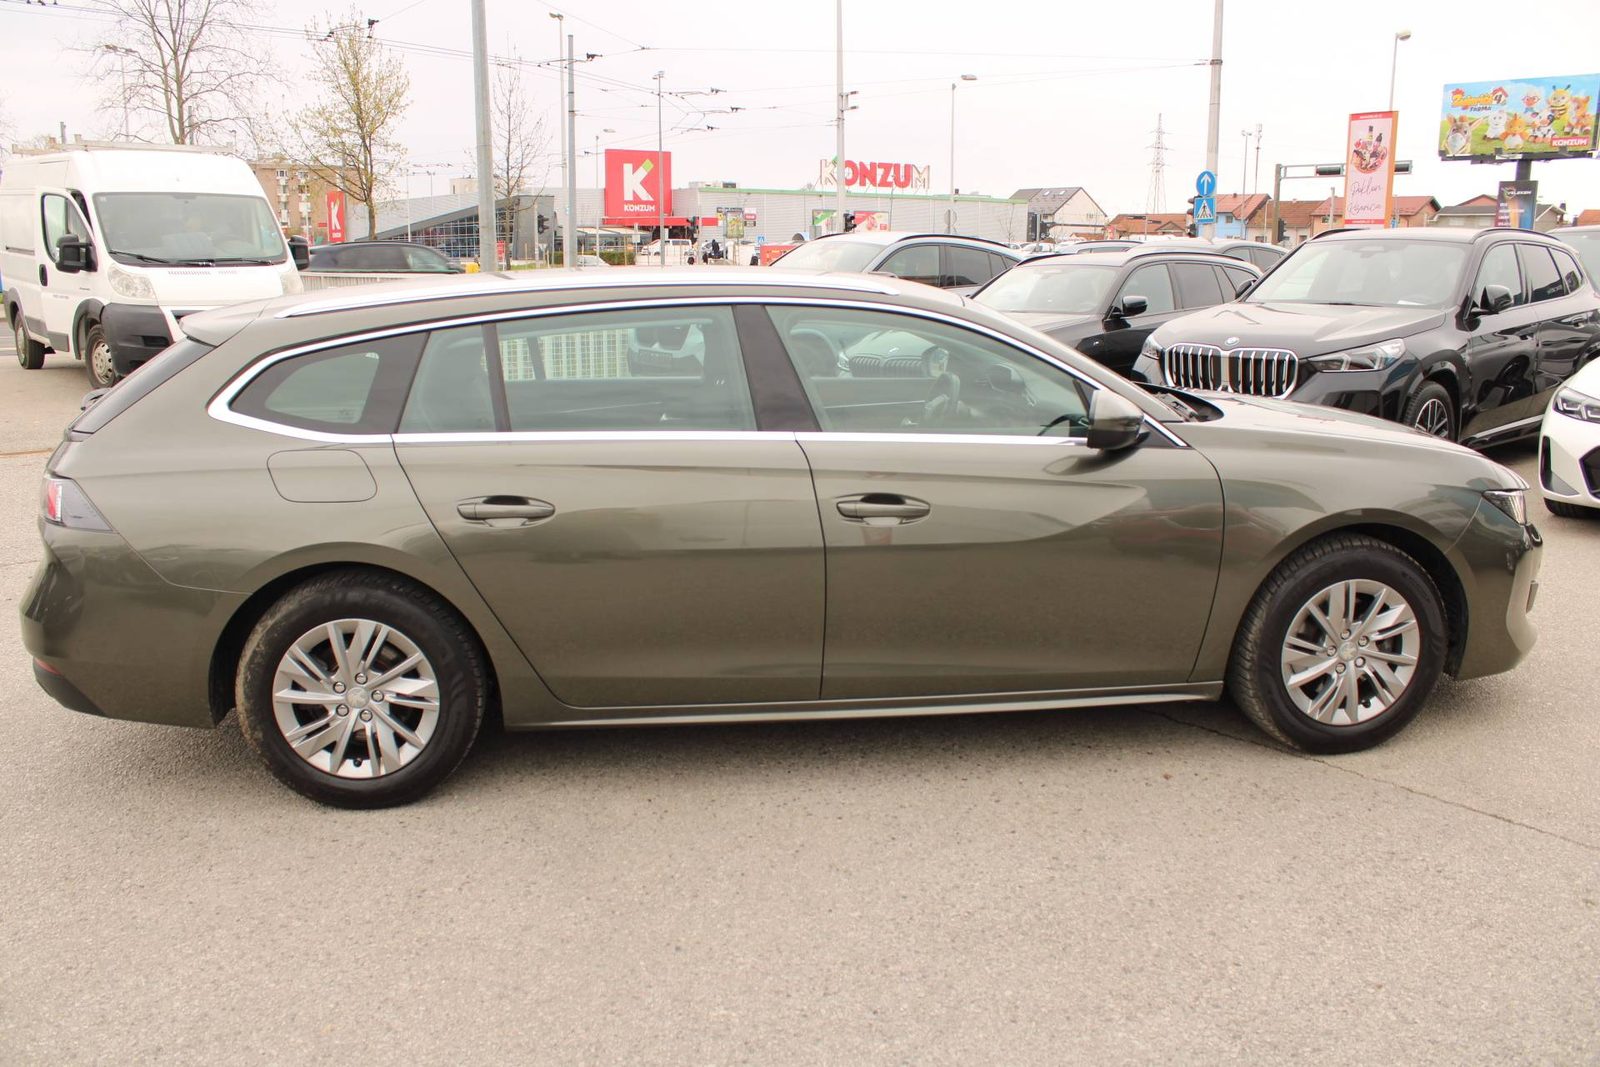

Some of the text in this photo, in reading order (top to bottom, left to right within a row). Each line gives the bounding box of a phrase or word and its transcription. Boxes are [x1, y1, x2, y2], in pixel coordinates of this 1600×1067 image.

[1552, 138, 1587, 147] KONZUM
[623, 158, 655, 202] K
[820, 157, 930, 189] KONZUM
[623, 204, 656, 212] KONZUM
